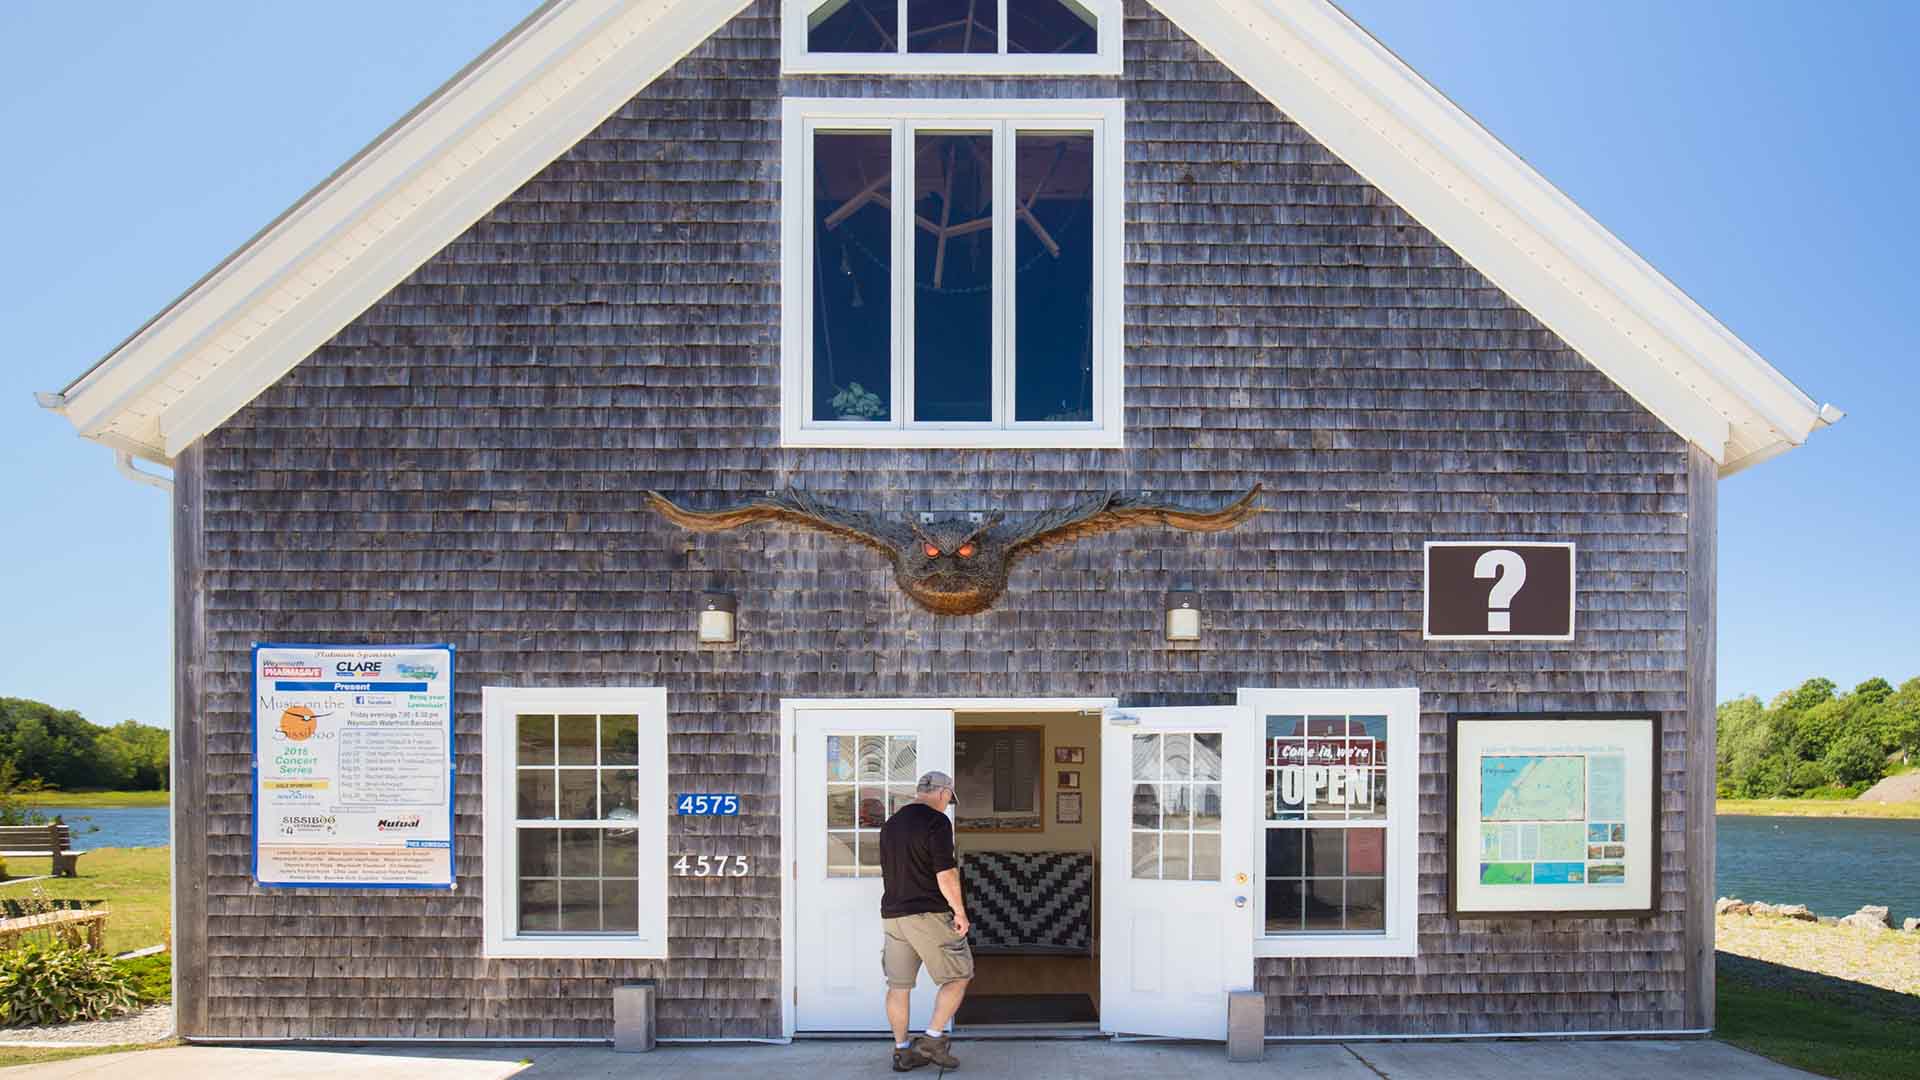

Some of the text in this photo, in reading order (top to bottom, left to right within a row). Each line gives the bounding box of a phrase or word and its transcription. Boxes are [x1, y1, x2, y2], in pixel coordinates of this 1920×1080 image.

[335, 661, 382, 672] CLARE
[334, 682, 370, 691] Present
[260, 695, 345, 711] Music on the
[350, 711, 369, 719] Friday
[1282, 745, 1315, 758] Come
[1337, 746, 1369, 758] we're
[275, 755, 318, 765] Concert
[279, 765, 313, 775] Series
[1281, 764, 1369, 805] OPEN
[679, 795, 737, 814] 4575
[282, 815, 336, 824] SISSIBOO
[377, 819, 420, 828] Mutual
[673, 855, 749, 877] 4575
